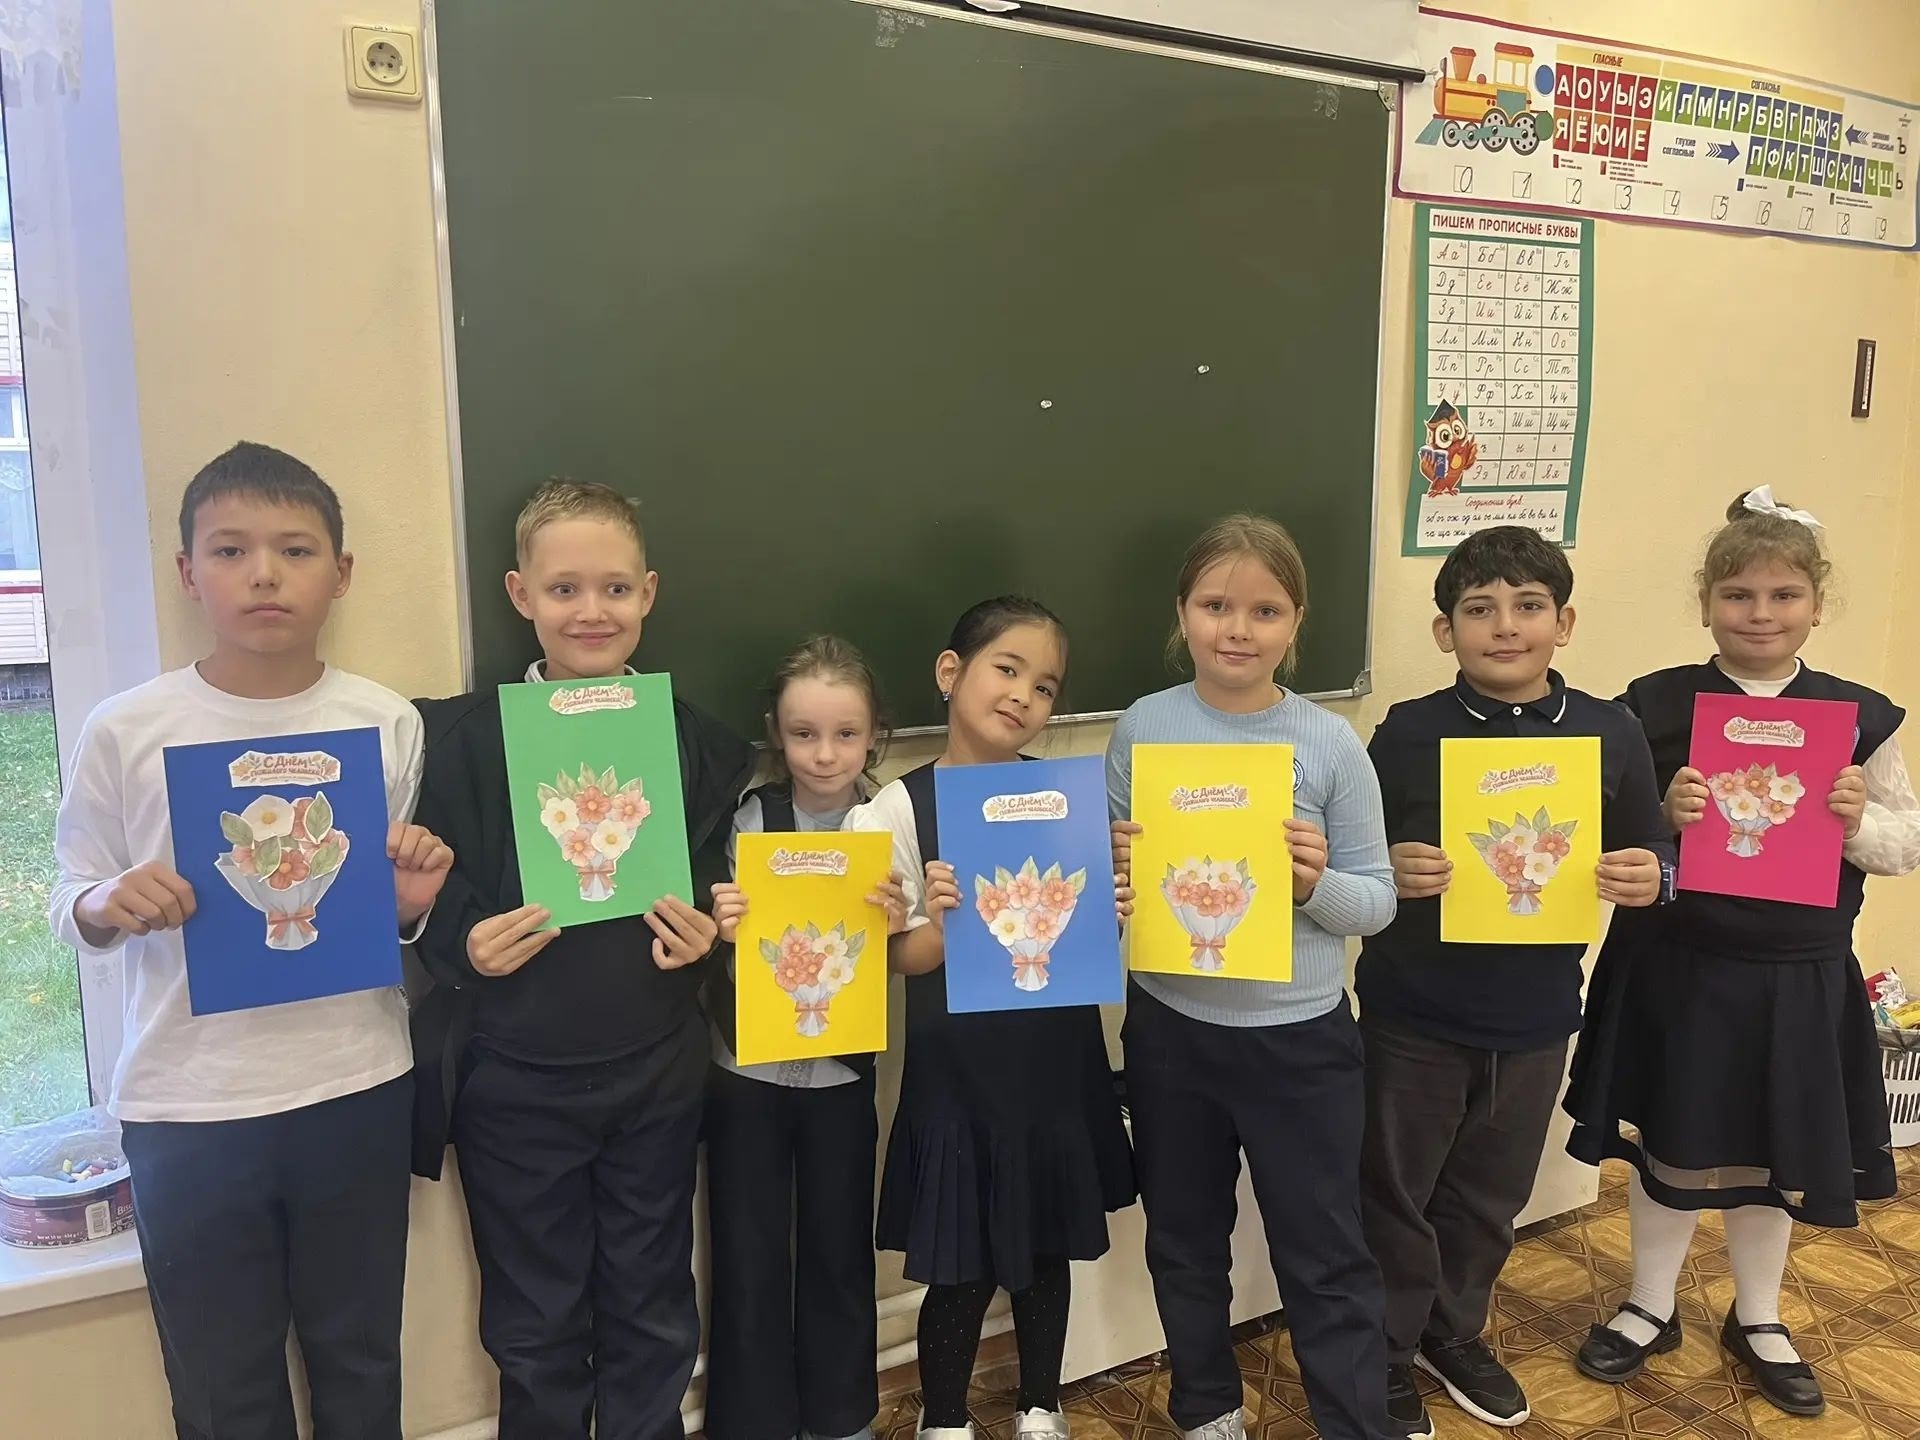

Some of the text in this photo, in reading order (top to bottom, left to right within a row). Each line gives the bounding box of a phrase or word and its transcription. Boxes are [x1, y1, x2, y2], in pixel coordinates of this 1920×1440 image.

[1592, 53, 1624, 67] ГЛАСНЫЕ
[1460, 166, 1887, 239] 0 1 2 3 4 5 6 7 8 9
[1433, 214, 1578, 239] ПИШЕМ ПРОПИСНЫЕ БУКВЫ
[263, 756, 274, 768] С
